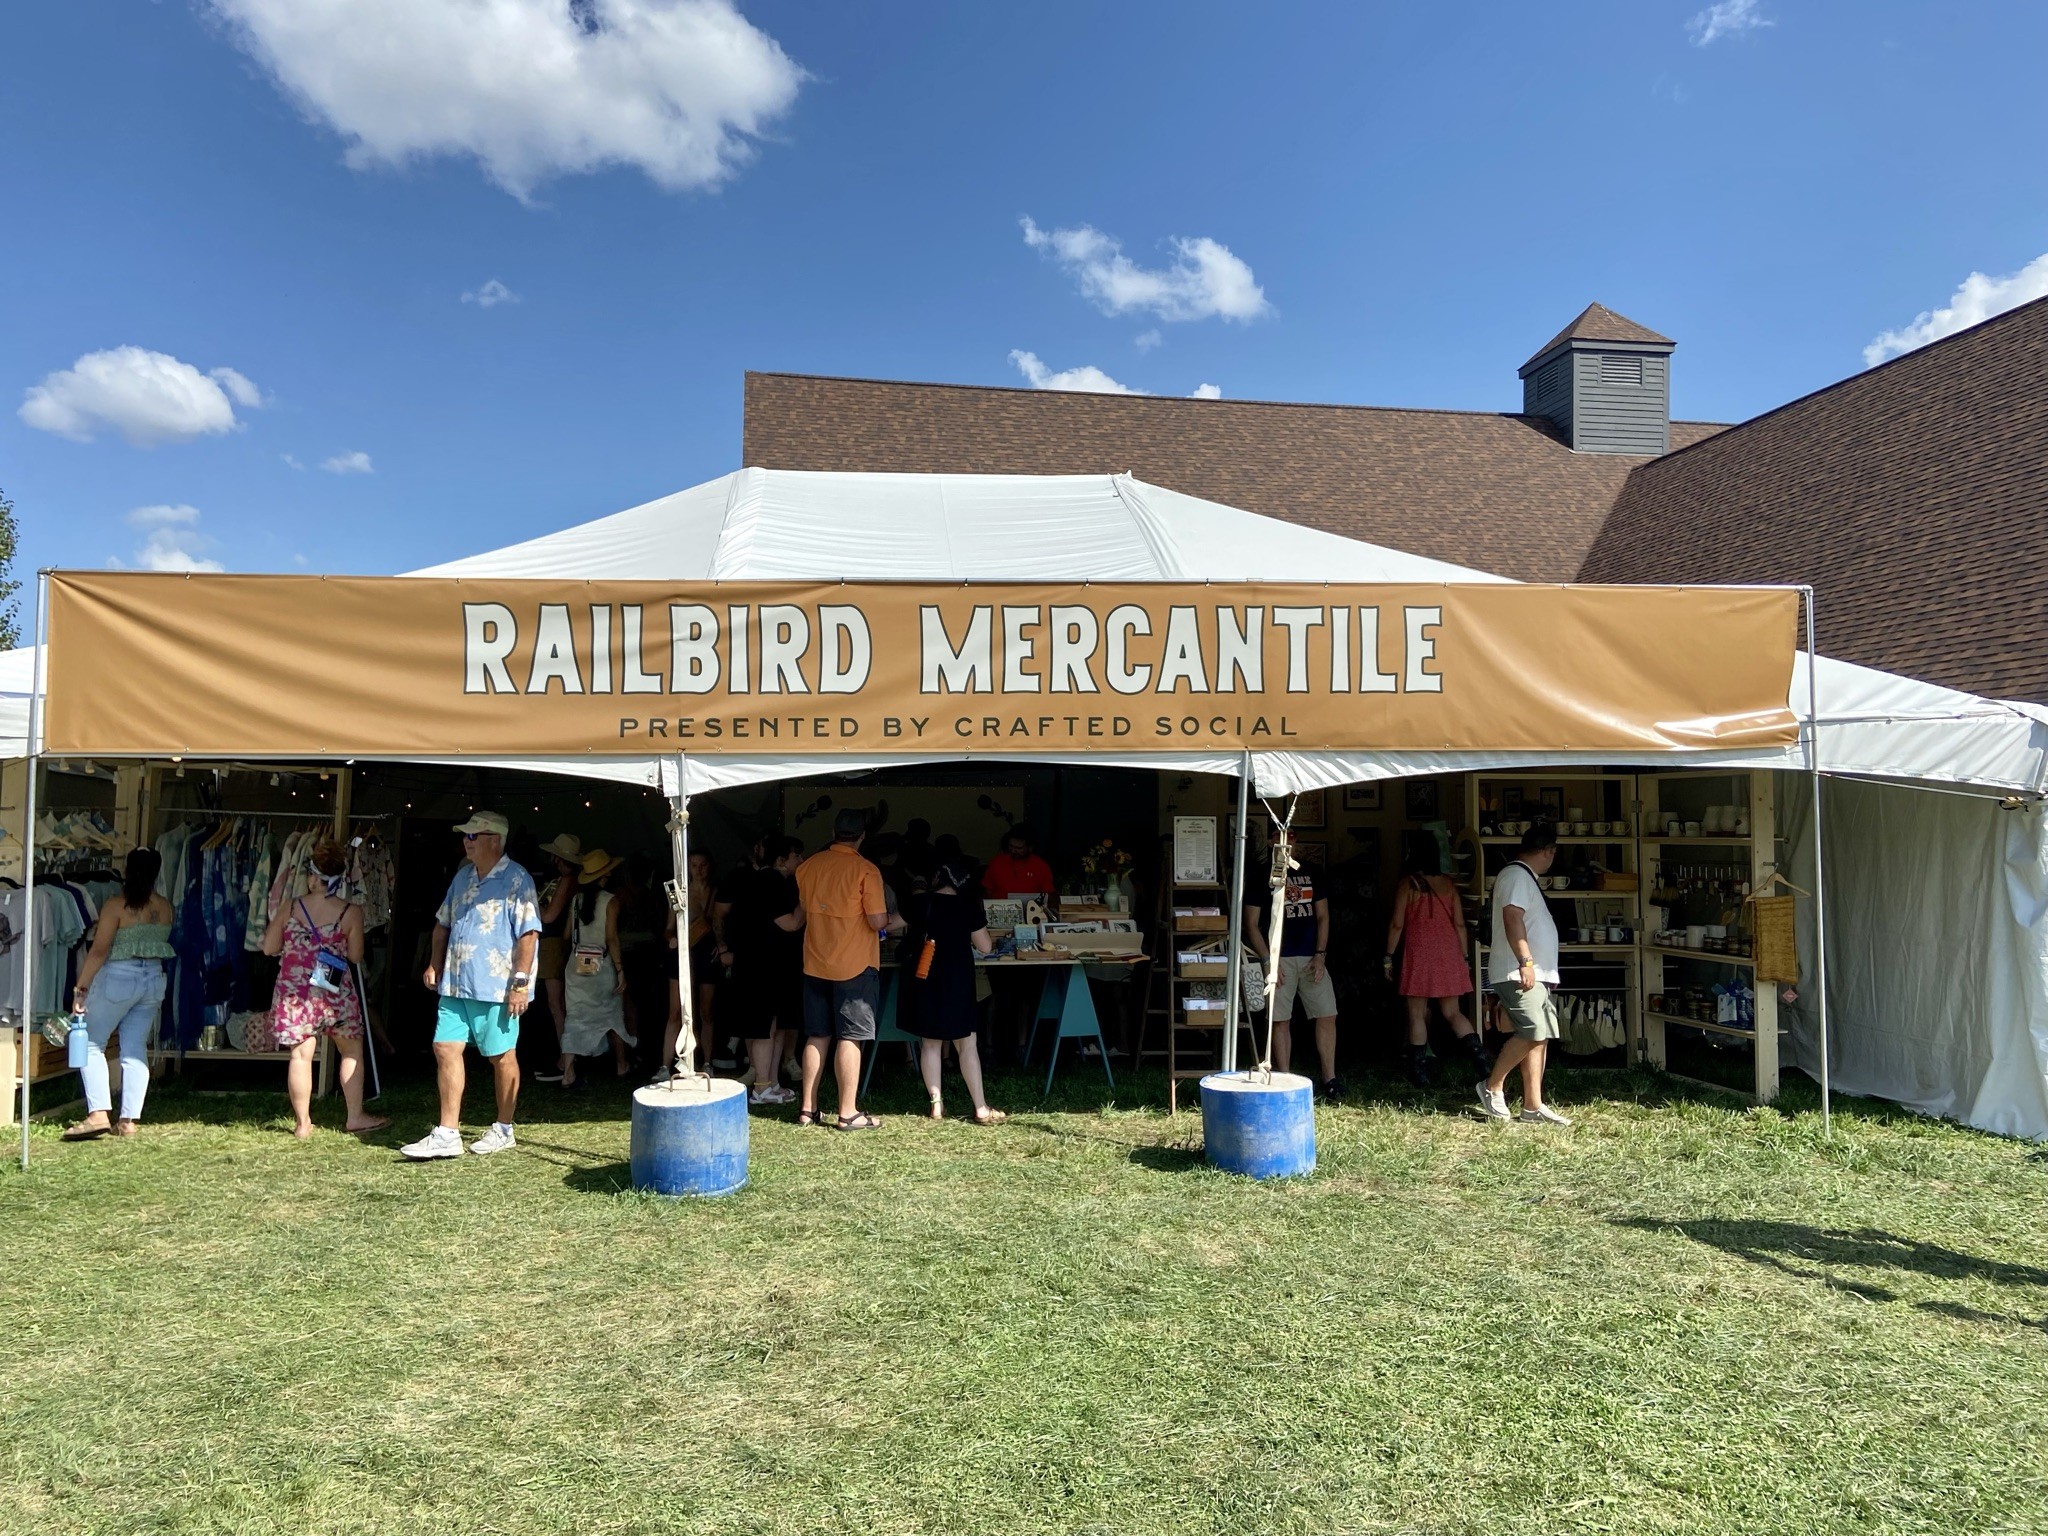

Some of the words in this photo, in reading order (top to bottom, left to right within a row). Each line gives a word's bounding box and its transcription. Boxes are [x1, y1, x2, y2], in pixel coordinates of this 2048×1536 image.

[461, 600, 874, 697] RAILBIRD
[918, 602, 1444, 696] MERCANTILE
[618, 717, 859, 738] PRESENTED
[882, 717, 931, 737] BY
[953, 716, 1132, 737] CRAFTED
[1154, 715, 1298, 736] SOCIAL
